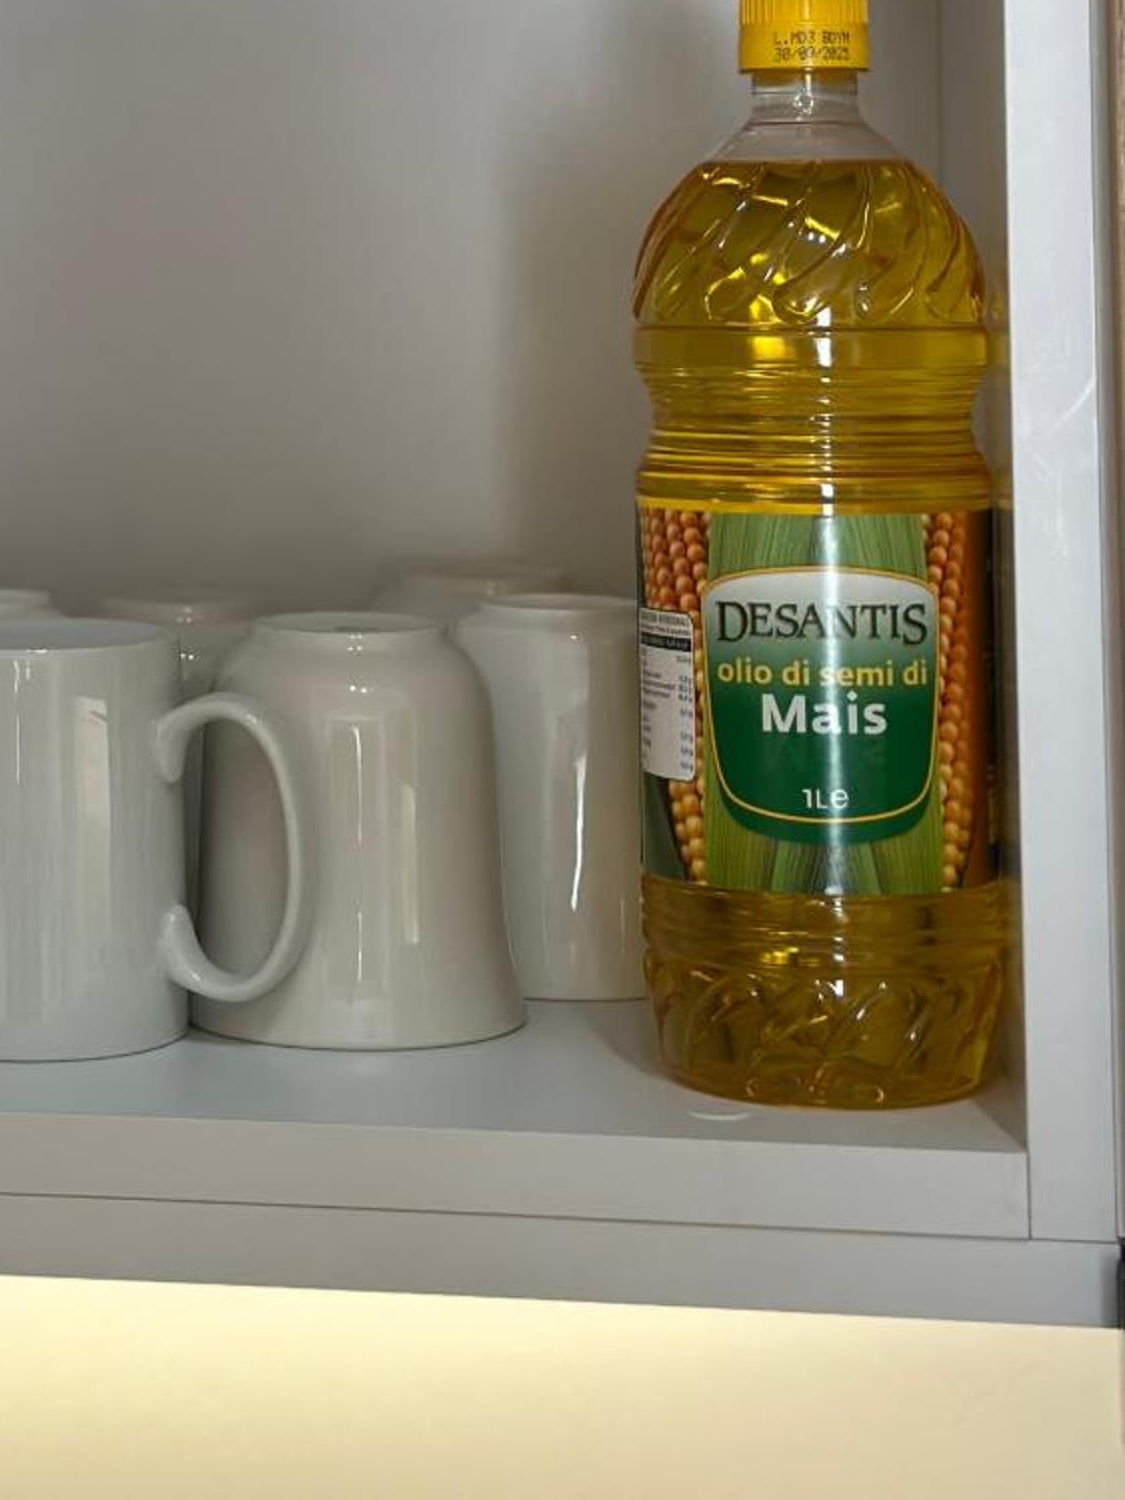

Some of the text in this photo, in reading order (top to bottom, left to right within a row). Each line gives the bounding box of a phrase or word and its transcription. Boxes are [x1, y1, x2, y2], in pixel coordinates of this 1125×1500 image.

[715, 601, 928, 646] DESANTIS
[717, 657, 928, 687] olio di semi di
[761, 690, 888, 736] Mais
